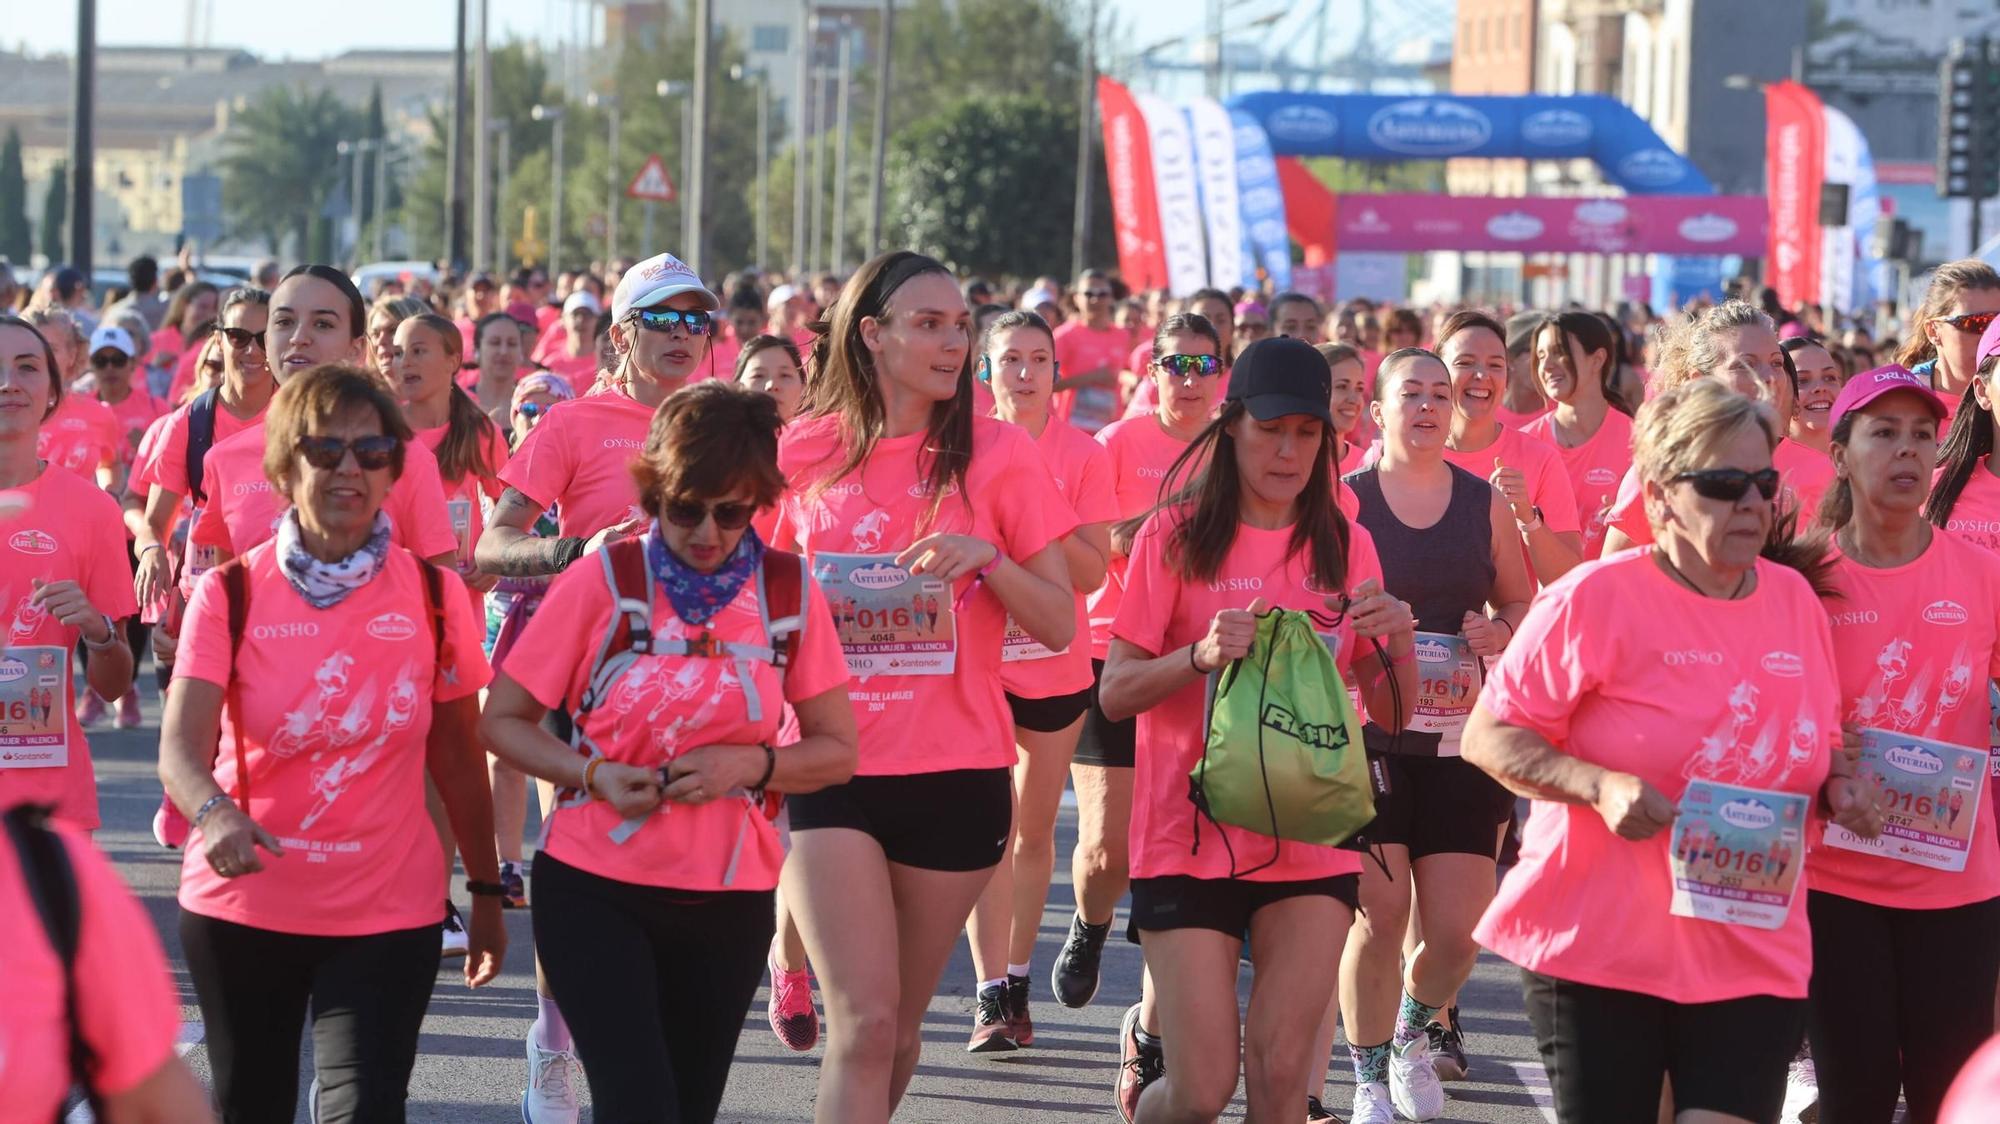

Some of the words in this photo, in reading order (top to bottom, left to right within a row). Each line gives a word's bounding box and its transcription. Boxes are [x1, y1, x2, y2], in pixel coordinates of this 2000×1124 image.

[1946, 519, 2000, 534] OYSHO
[853, 571, 906, 585] ASTURIANA
[858, 608, 910, 629] 016
[253, 621, 320, 640] OYSHO
[870, 633, 896, 642] 4048
[868, 645, 878, 653] LA
[880, 643, 906, 652] MUJER
[912, 642, 948, 651] VALENCIA
[1416, 649, 1450, 658] STURIANA
[848, 659, 873, 669] SHO
[901, 659, 942, 668] Santander
[1422, 678, 1448, 696] 16
[14, 752, 53, 760] Santander
[1888, 751, 1940, 772] ASTURIANA
[1887, 814, 1913, 827] 8747
[1895, 827, 1920, 840] MUJER
[1926, 833, 1961, 849] VALENCIA
[1714, 847, 1763, 873] 016
[1910, 847, 1952, 863] Santander
